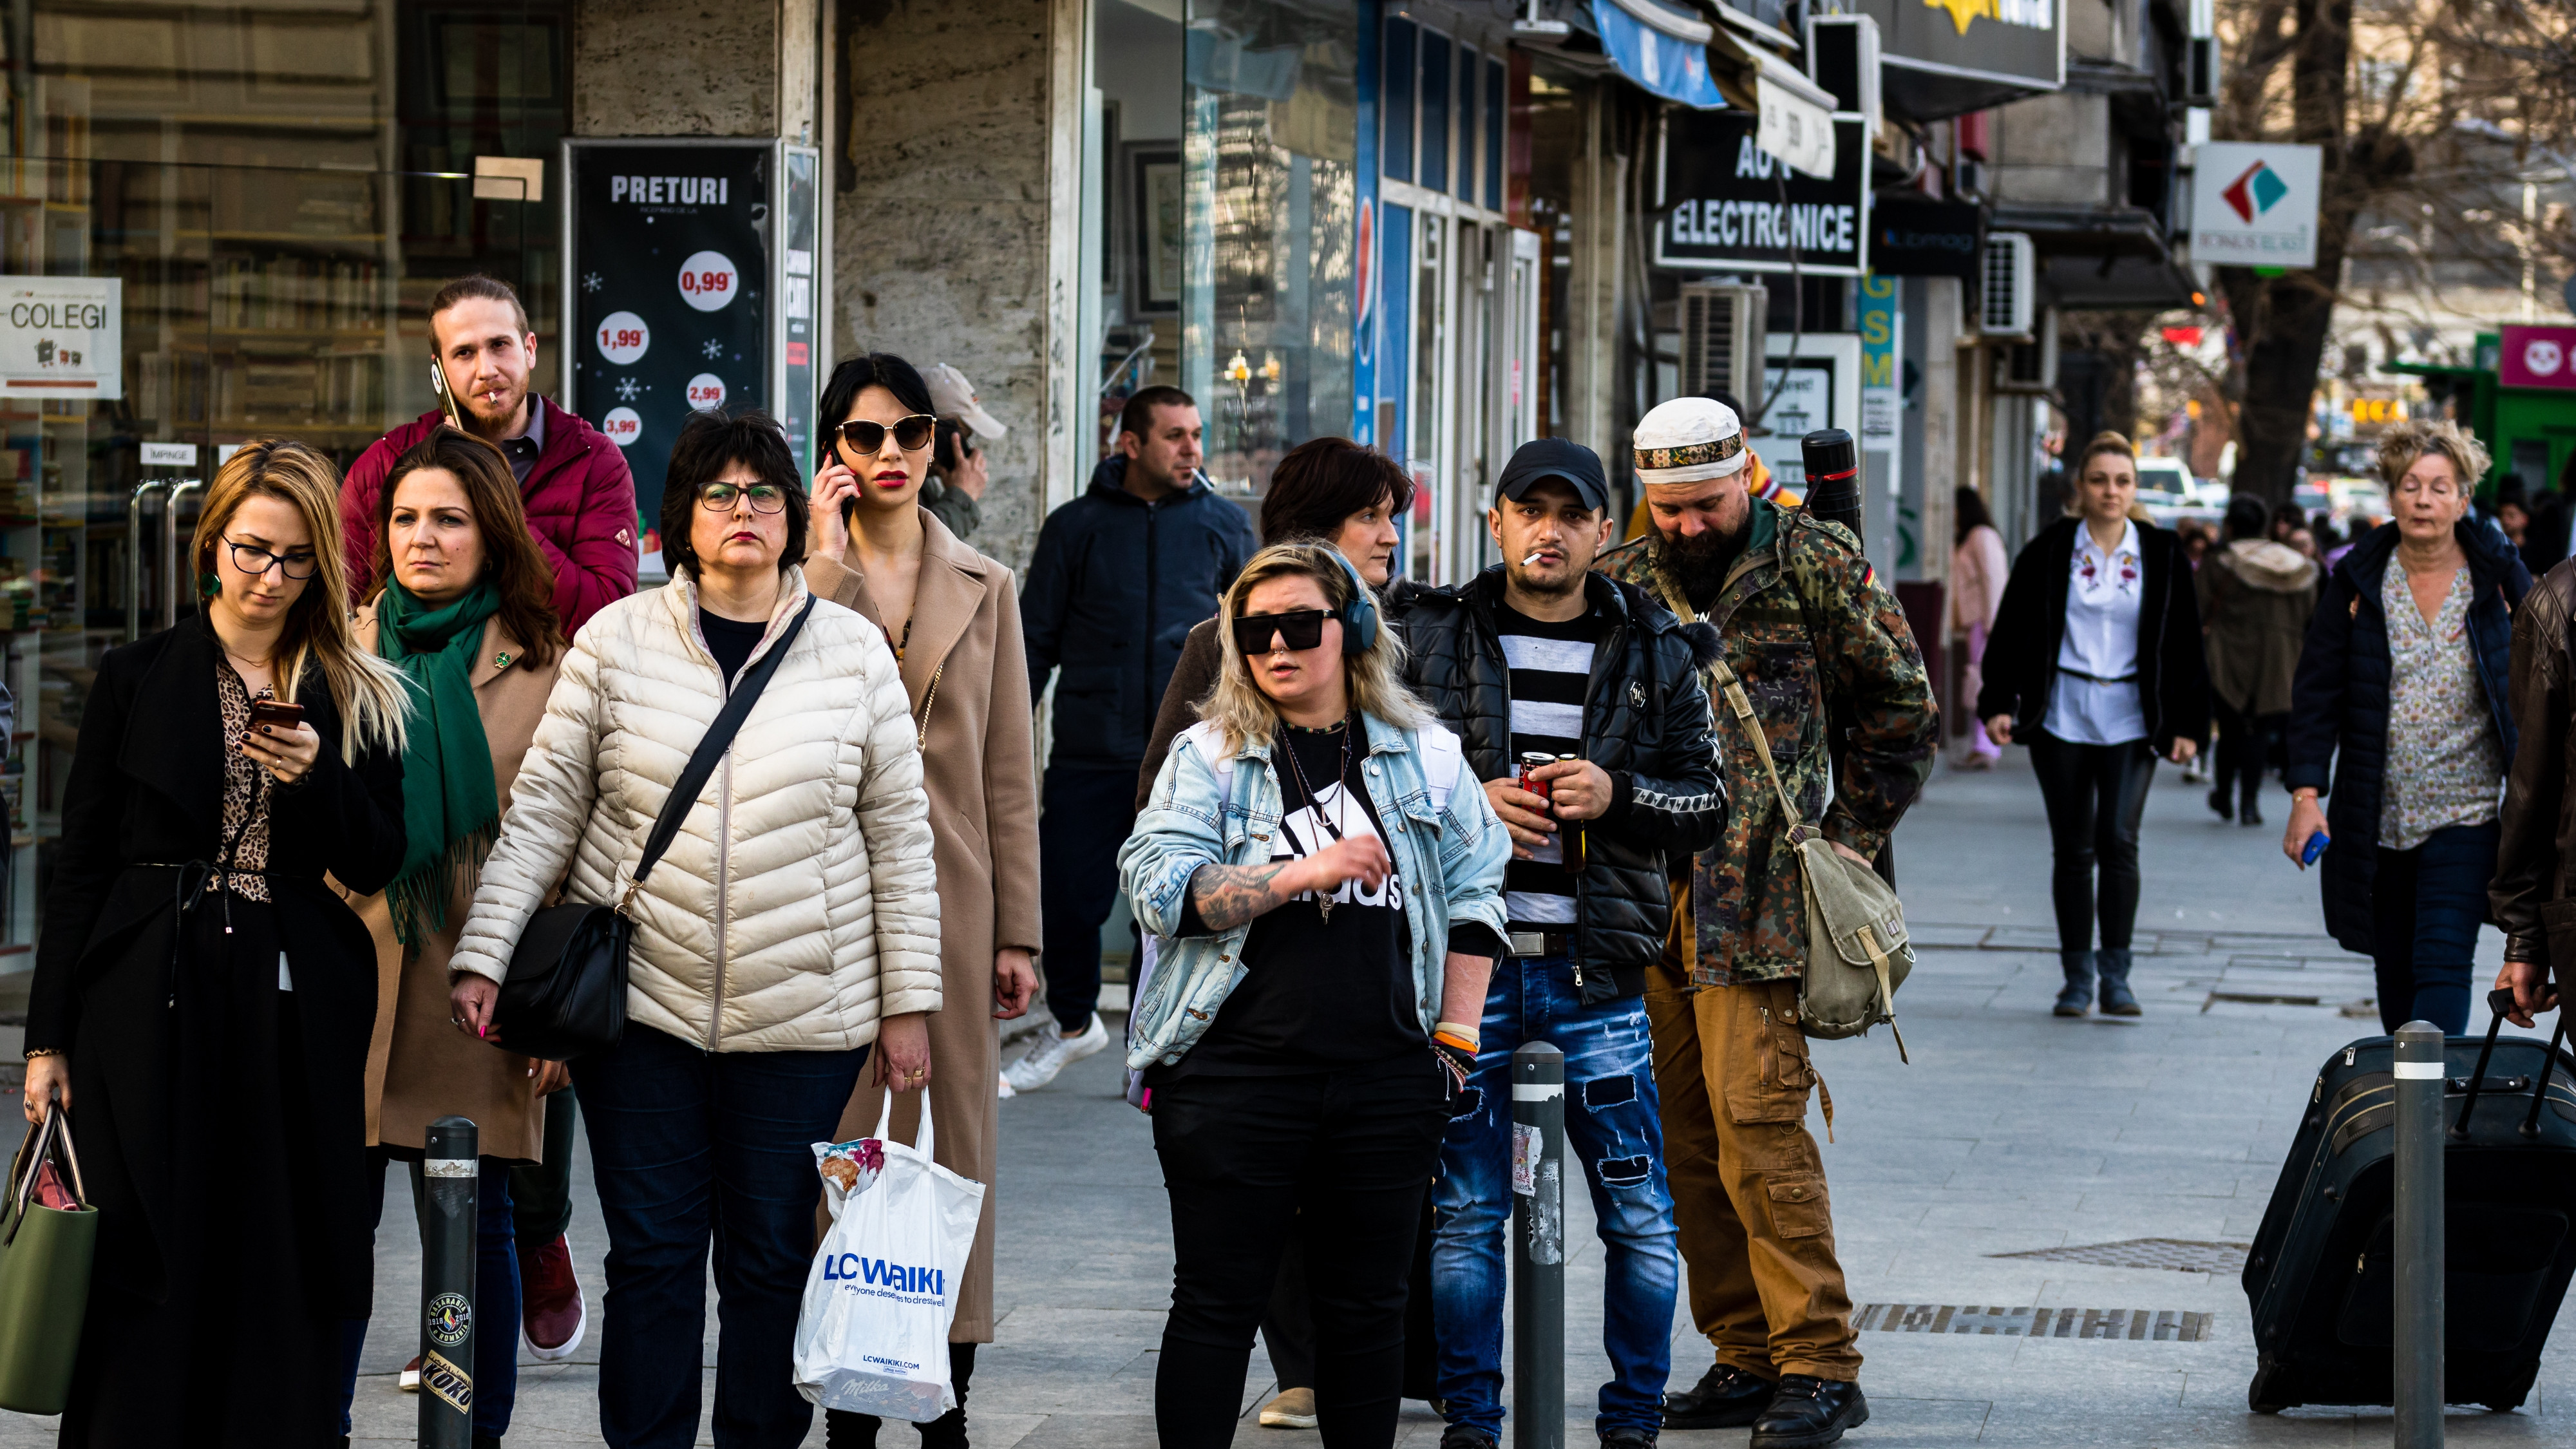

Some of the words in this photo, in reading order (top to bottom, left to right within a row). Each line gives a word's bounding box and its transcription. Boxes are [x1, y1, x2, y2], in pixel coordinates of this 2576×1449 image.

[612, 176, 728, 204] PRETURI
[1672, 198, 1855, 252] ELECTRONICE
[11, 303, 106, 330] COLEGI
[430, 1298, 466, 1316] BASARABIA
[455, 1313, 469, 1322] 2018
[863, 1354, 920, 1370] LCWAIKIKI.COM
[422, 1363, 472, 1406] KOKO
[840, 1378, 889, 1397] Milka
